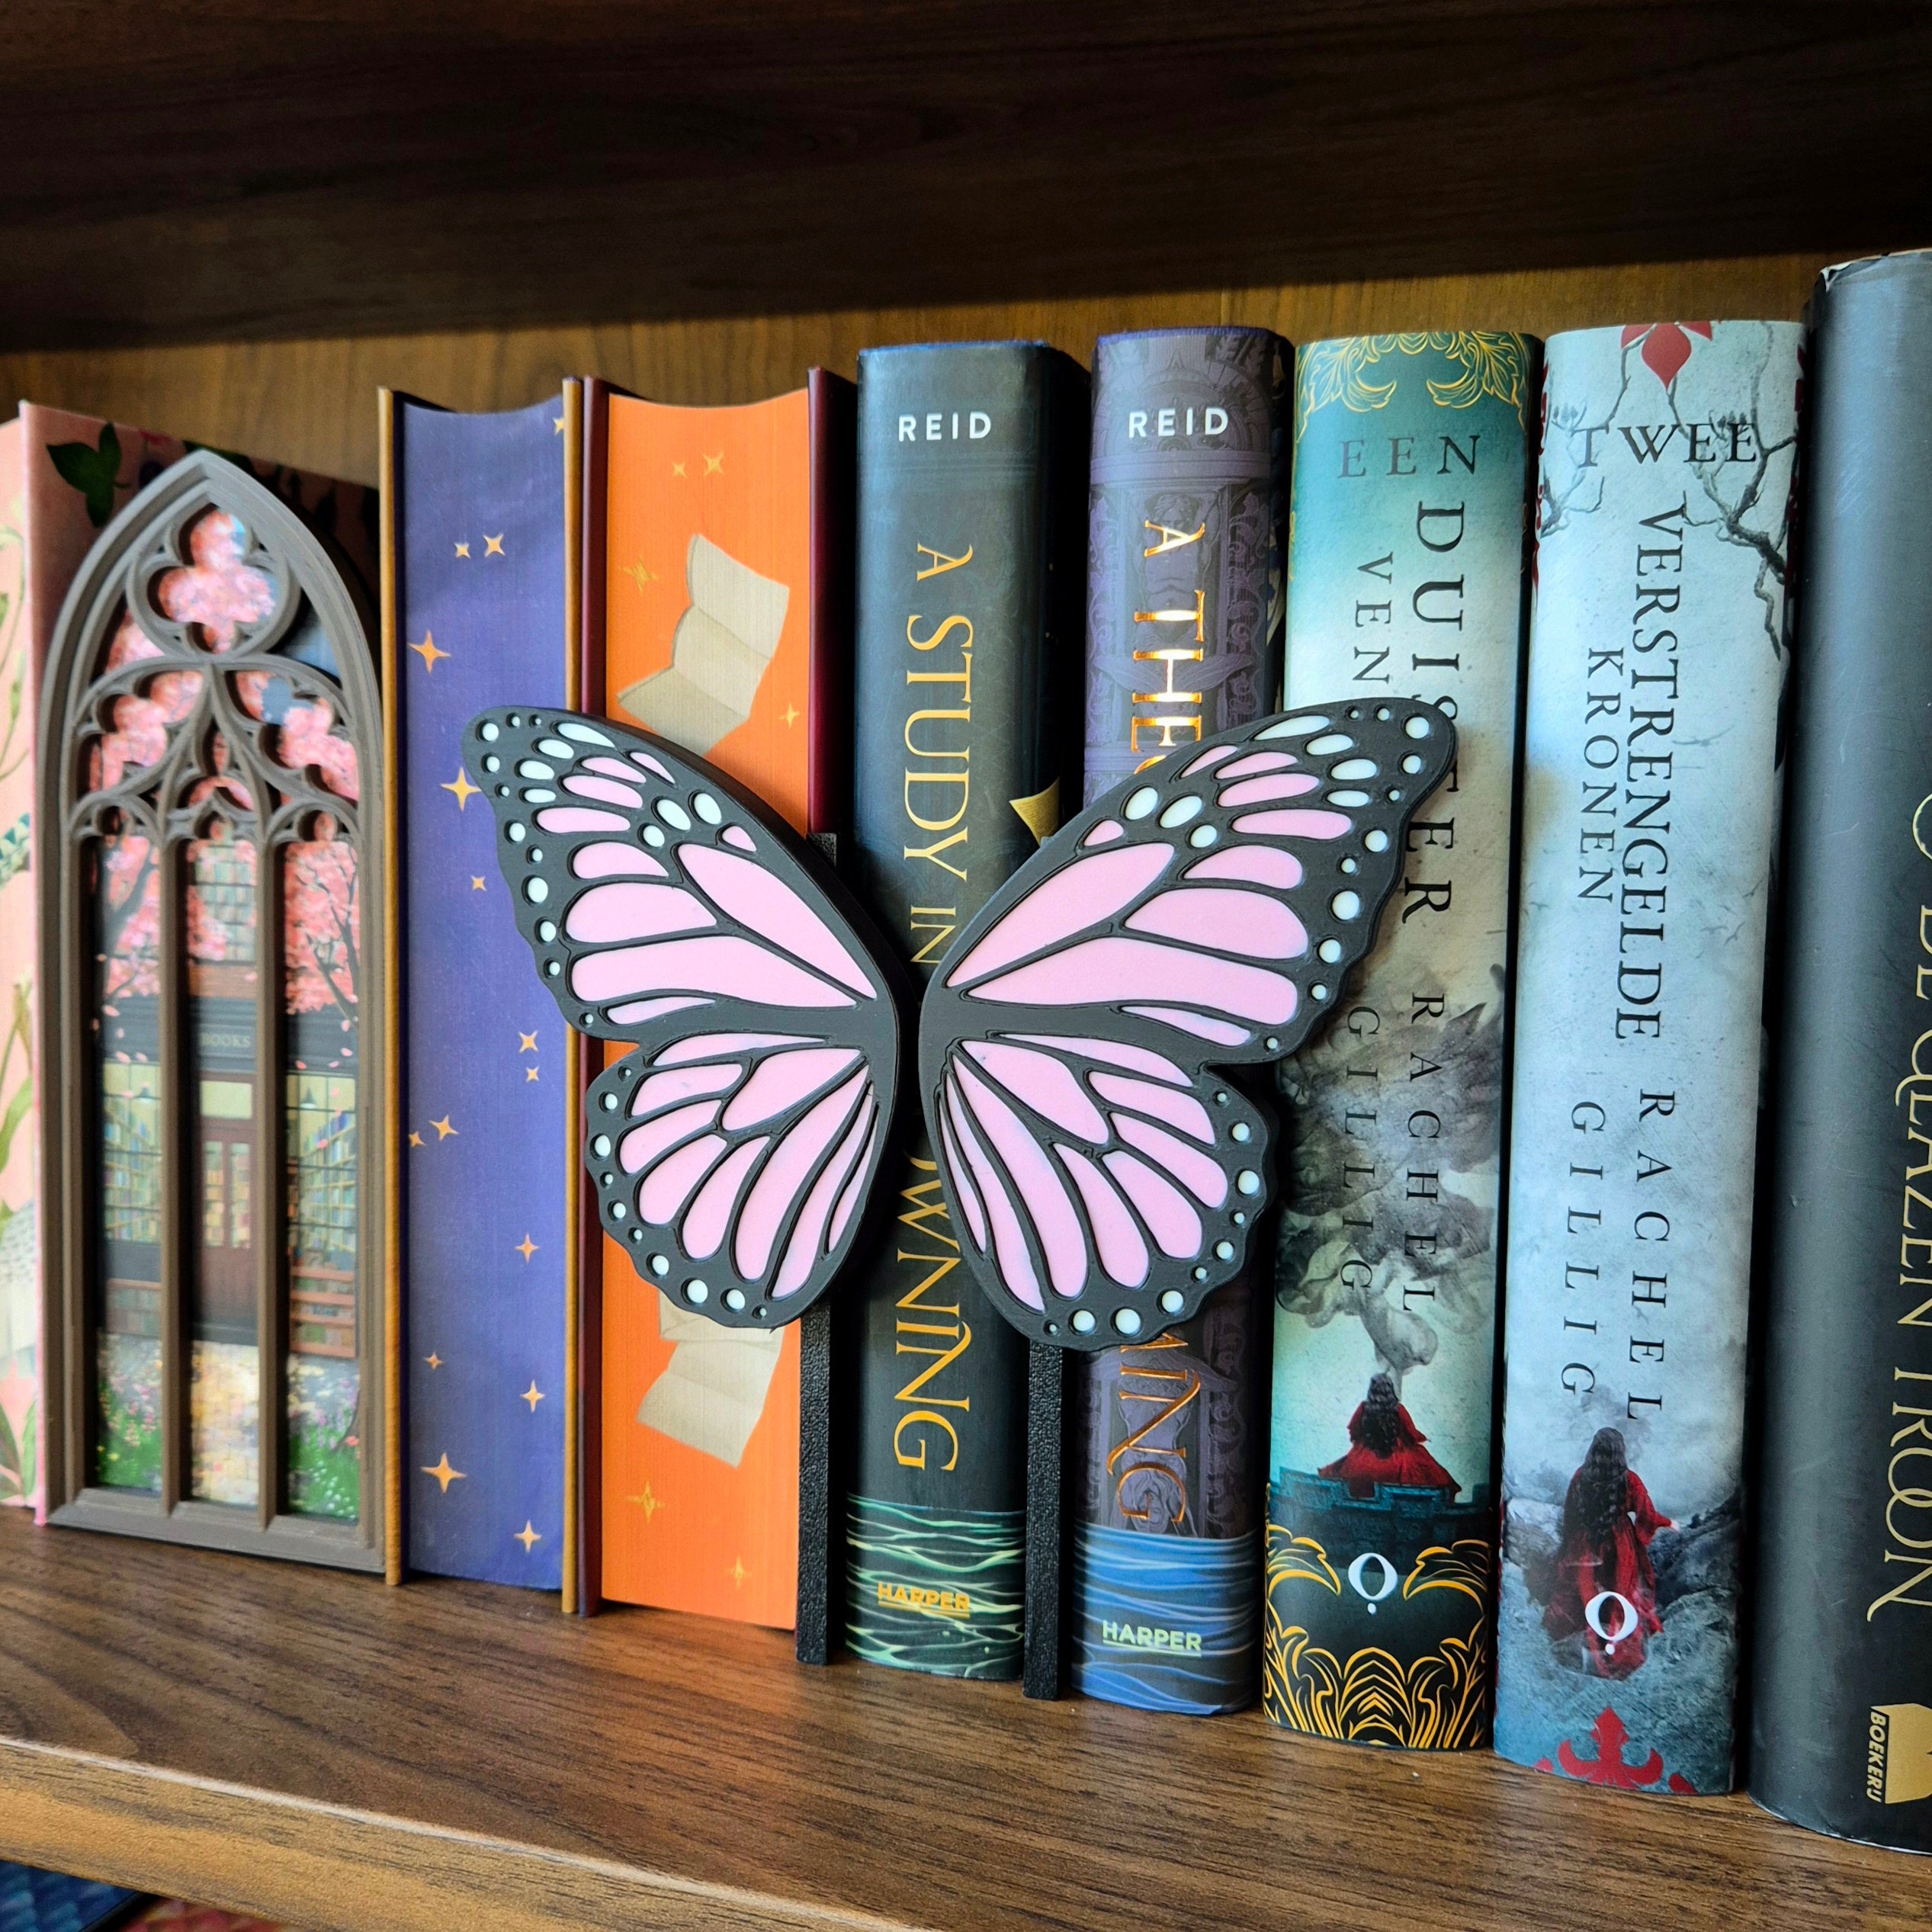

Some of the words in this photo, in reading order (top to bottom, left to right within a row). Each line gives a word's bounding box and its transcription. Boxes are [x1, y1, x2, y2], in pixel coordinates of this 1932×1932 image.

[898, 410, 992, 442] REID
[1129, 407, 1229, 438] REID
[1337, 434, 1481, 480] EEN
[1572, 422, 1757, 468] TWEE
[916, 542, 974, 582] A
[1144, 519, 1205, 558] A
[1353, 550, 1394, 685] VEN
[903, 614, 974, 882] STUDY
[1130, 589, 1205, 775] THE
[1402, 500, 1465, 925] DUIER
[1578, 647, 1624, 903] KRONEN
[1614, 503, 1686, 1040] VERSTRENGELDE
[910, 904, 957, 964] IN
[1340, 1005, 1381, 1290] GILLIG
[1402, 992, 1445, 1312] RACHEL
[894, 1151, 972, 1471] WNING
[1559, 1100, 1606, 1396] GILLIG
[1627, 1088, 1677, 1420] RACHEL
[877, 1581, 971, 1613] HARPER
[1102, 1619, 1202, 1653] HARPER
